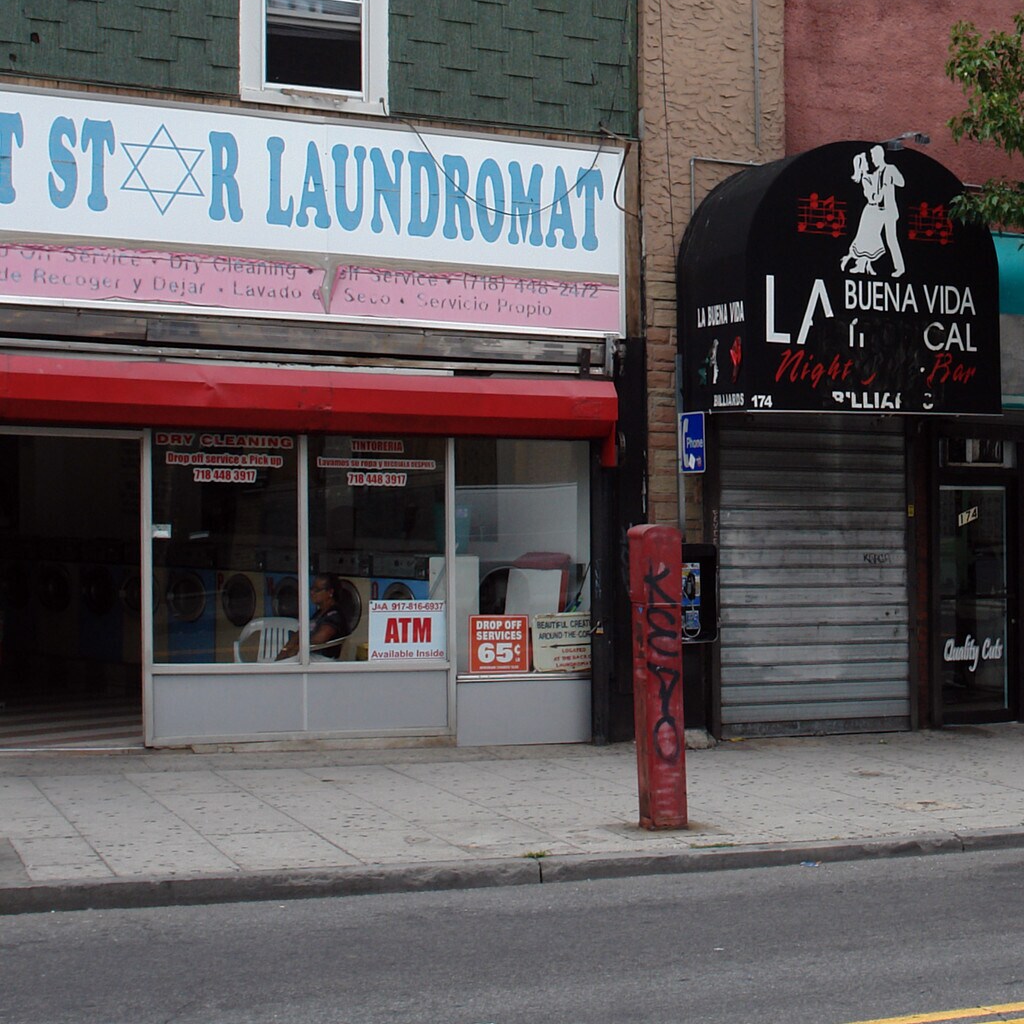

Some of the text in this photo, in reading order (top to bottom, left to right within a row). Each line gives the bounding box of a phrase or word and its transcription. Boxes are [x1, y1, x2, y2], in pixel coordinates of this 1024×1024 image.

[265, 135, 604, 251] LAUNDROMAT
[213, 257, 297, 280] Cleaning
[33, 268, 120, 291] Recoger
[132, 278, 143, 295] y
[153, 276, 206, 297] Dejar
[233, 280, 302, 300] Lavado
[416, 293, 489, 312] Servicio
[497, 301, 553, 321] Propio
[697, 300, 745, 328] LA BUENA VIDA
[765, 274, 835, 345] LA
[844, 279, 919, 314] BUENA
[922, 284, 977, 316] VIDA
[926, 352, 977, 389] Bar
[713, 392, 745, 407] BILLIARDS
[751, 394, 773, 408] 174
[156, 433, 293, 449] DRY CLEANING
[351, 440, 404, 453] TINTORERIA
[686, 436, 704, 450] Phone
[167, 452, 282, 468] Drop off service & Pick up
[317, 458, 350, 468] Lavamos
[360, 460, 377, 470] ropa
[193, 469, 256, 483] 718 448 3917
[348, 473, 407, 486] 718 448 3917
[957, 505, 979, 527] 174
[391, 602, 443, 611] 917-816-6937
[384, 617, 432, 644] ATM
[476, 619, 522, 631] DROP OFF
[536, 619, 591, 630] BEAUTIFUL CREAT
[476, 630, 523, 641] SERVICES
[538, 631, 563, 640] AROUND
[371, 649, 445, 659] Available Inside
[943, 634, 1003, 672] Quality Cuts
